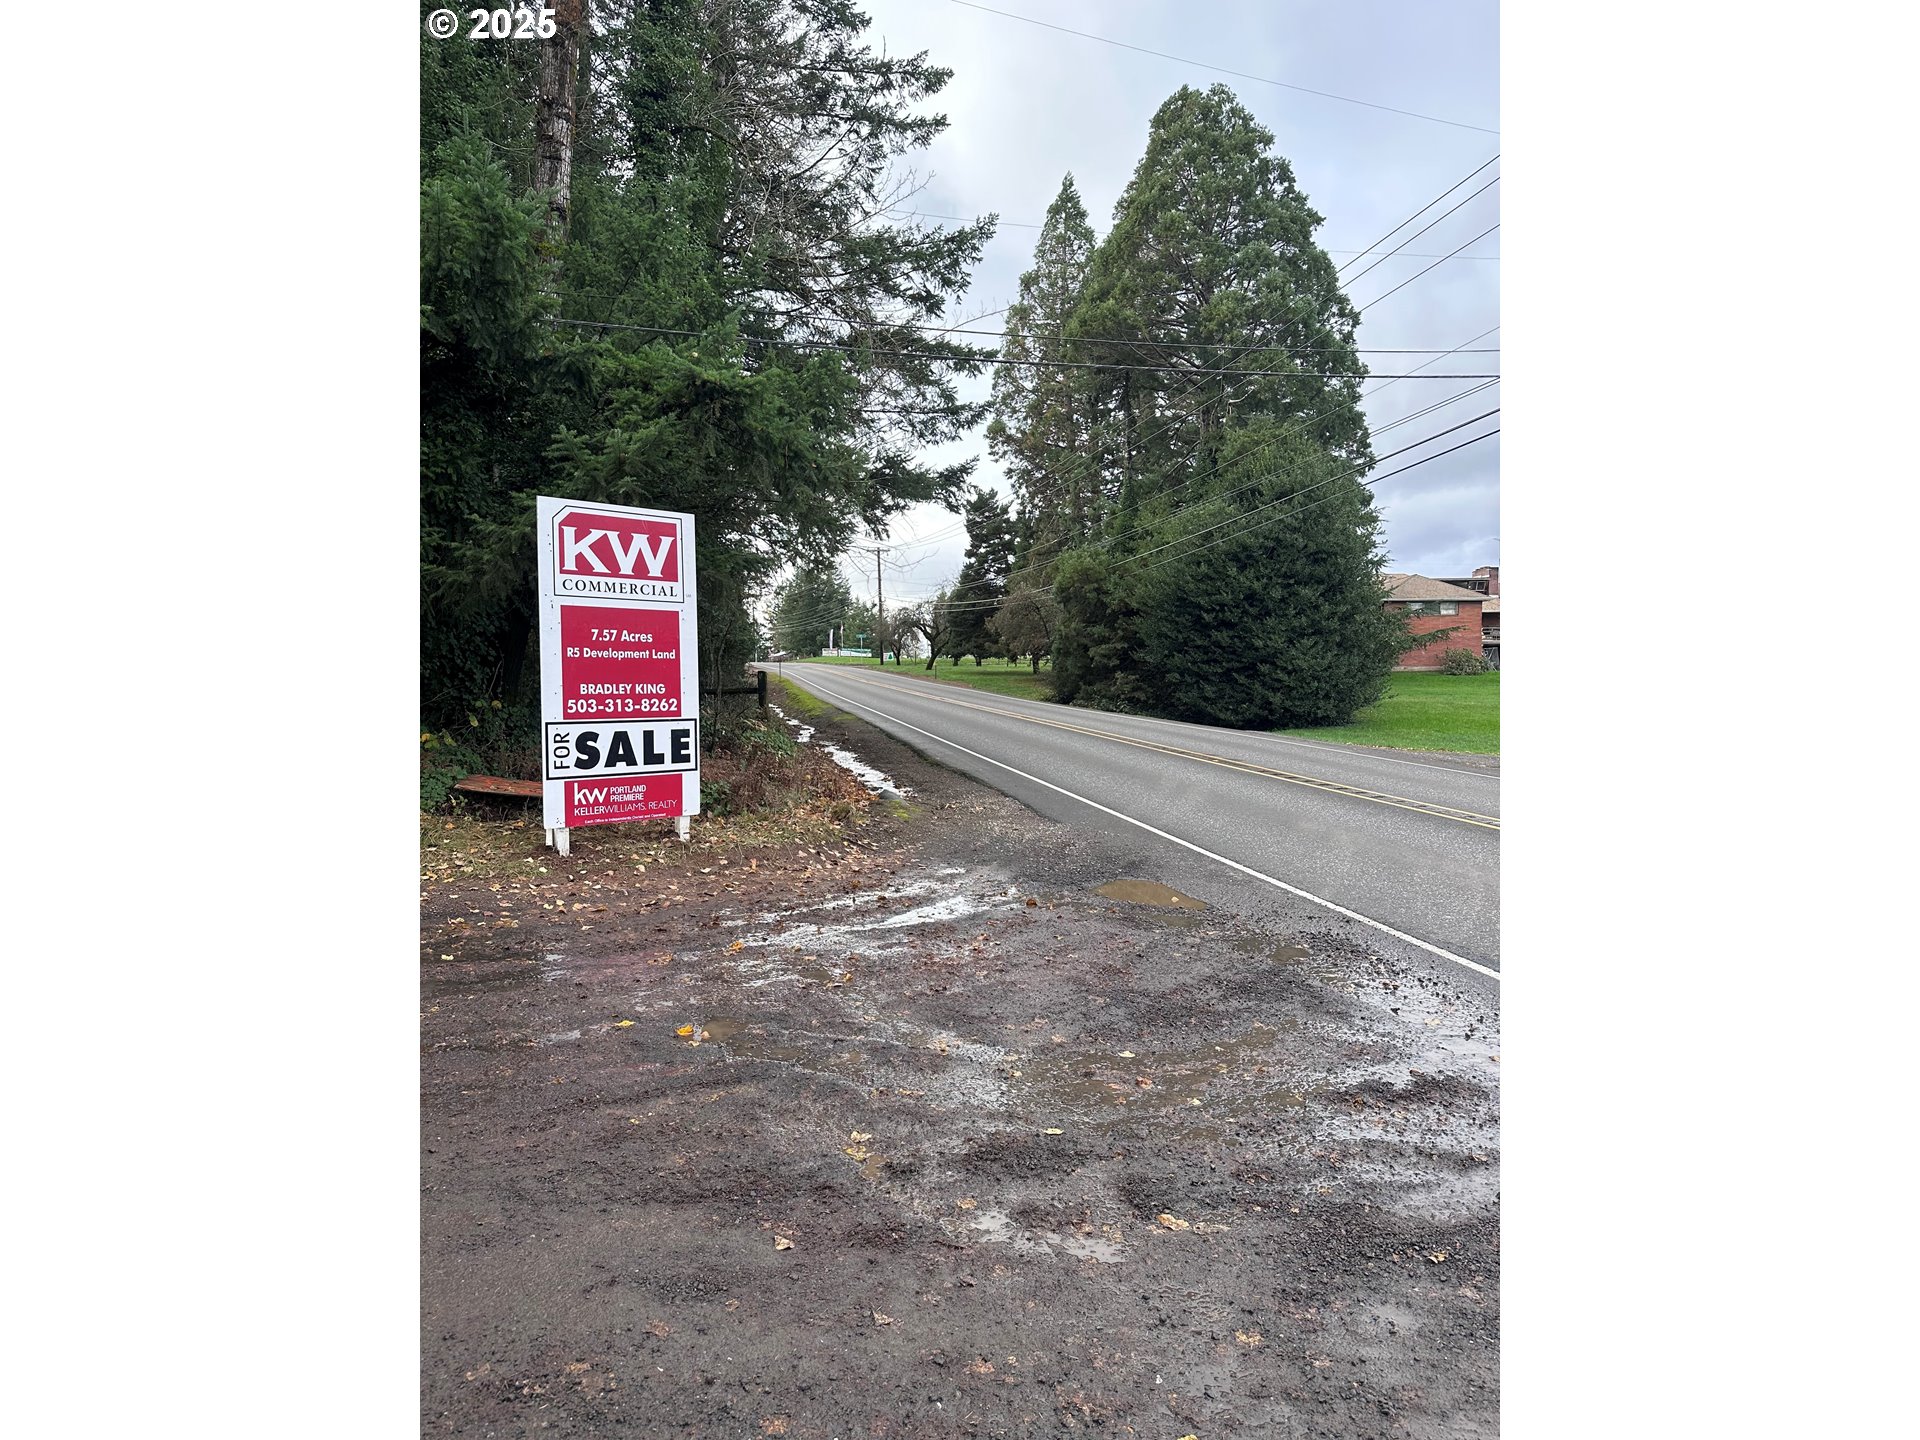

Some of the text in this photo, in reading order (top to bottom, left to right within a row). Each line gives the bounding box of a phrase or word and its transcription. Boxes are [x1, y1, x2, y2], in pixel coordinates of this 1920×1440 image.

[561, 525, 676, 578] KW
[562, 579, 678, 597] COMMERCIAL
[591, 628, 653, 643] 7.57 Acres
[566, 647, 676, 661] R5 Development Land
[580, 683, 666, 695] BRADLEY KING
[567, 698, 678, 713] 503-313-8262
[554, 732, 570, 769] FOR
[574, 729, 691, 770] SALE
[574, 783, 608, 805] kw
[610, 785, 646, 794] PORTLAND
[610, 793, 644, 802] PREMIERE
[648, 800, 678, 810] REALTY
